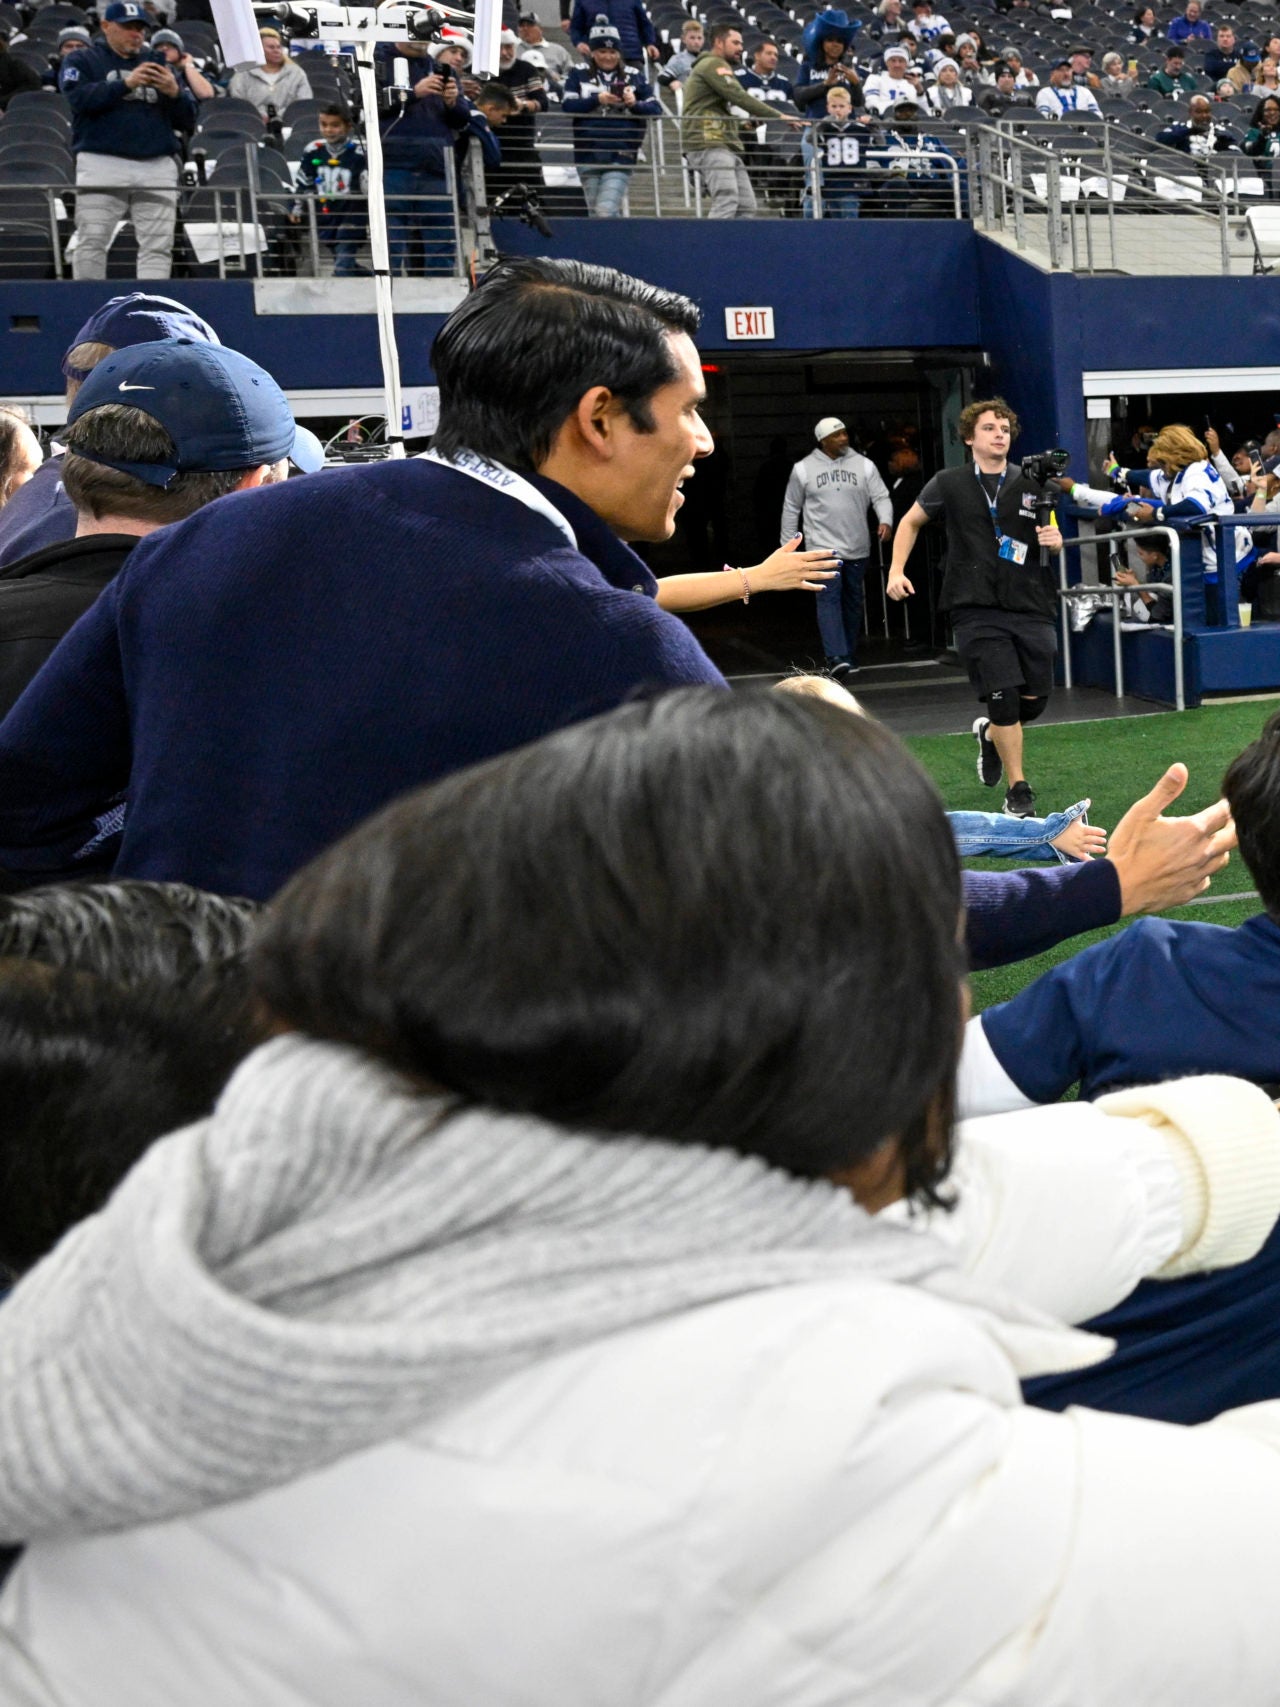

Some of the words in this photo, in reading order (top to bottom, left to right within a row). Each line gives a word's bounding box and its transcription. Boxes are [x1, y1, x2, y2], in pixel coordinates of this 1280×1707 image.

[827, 137, 860, 166] 88
[734, 310, 767, 336] EXIT
[816, 469, 858, 489] COWBOYS
[1018, 508, 1037, 520] MEDIA
